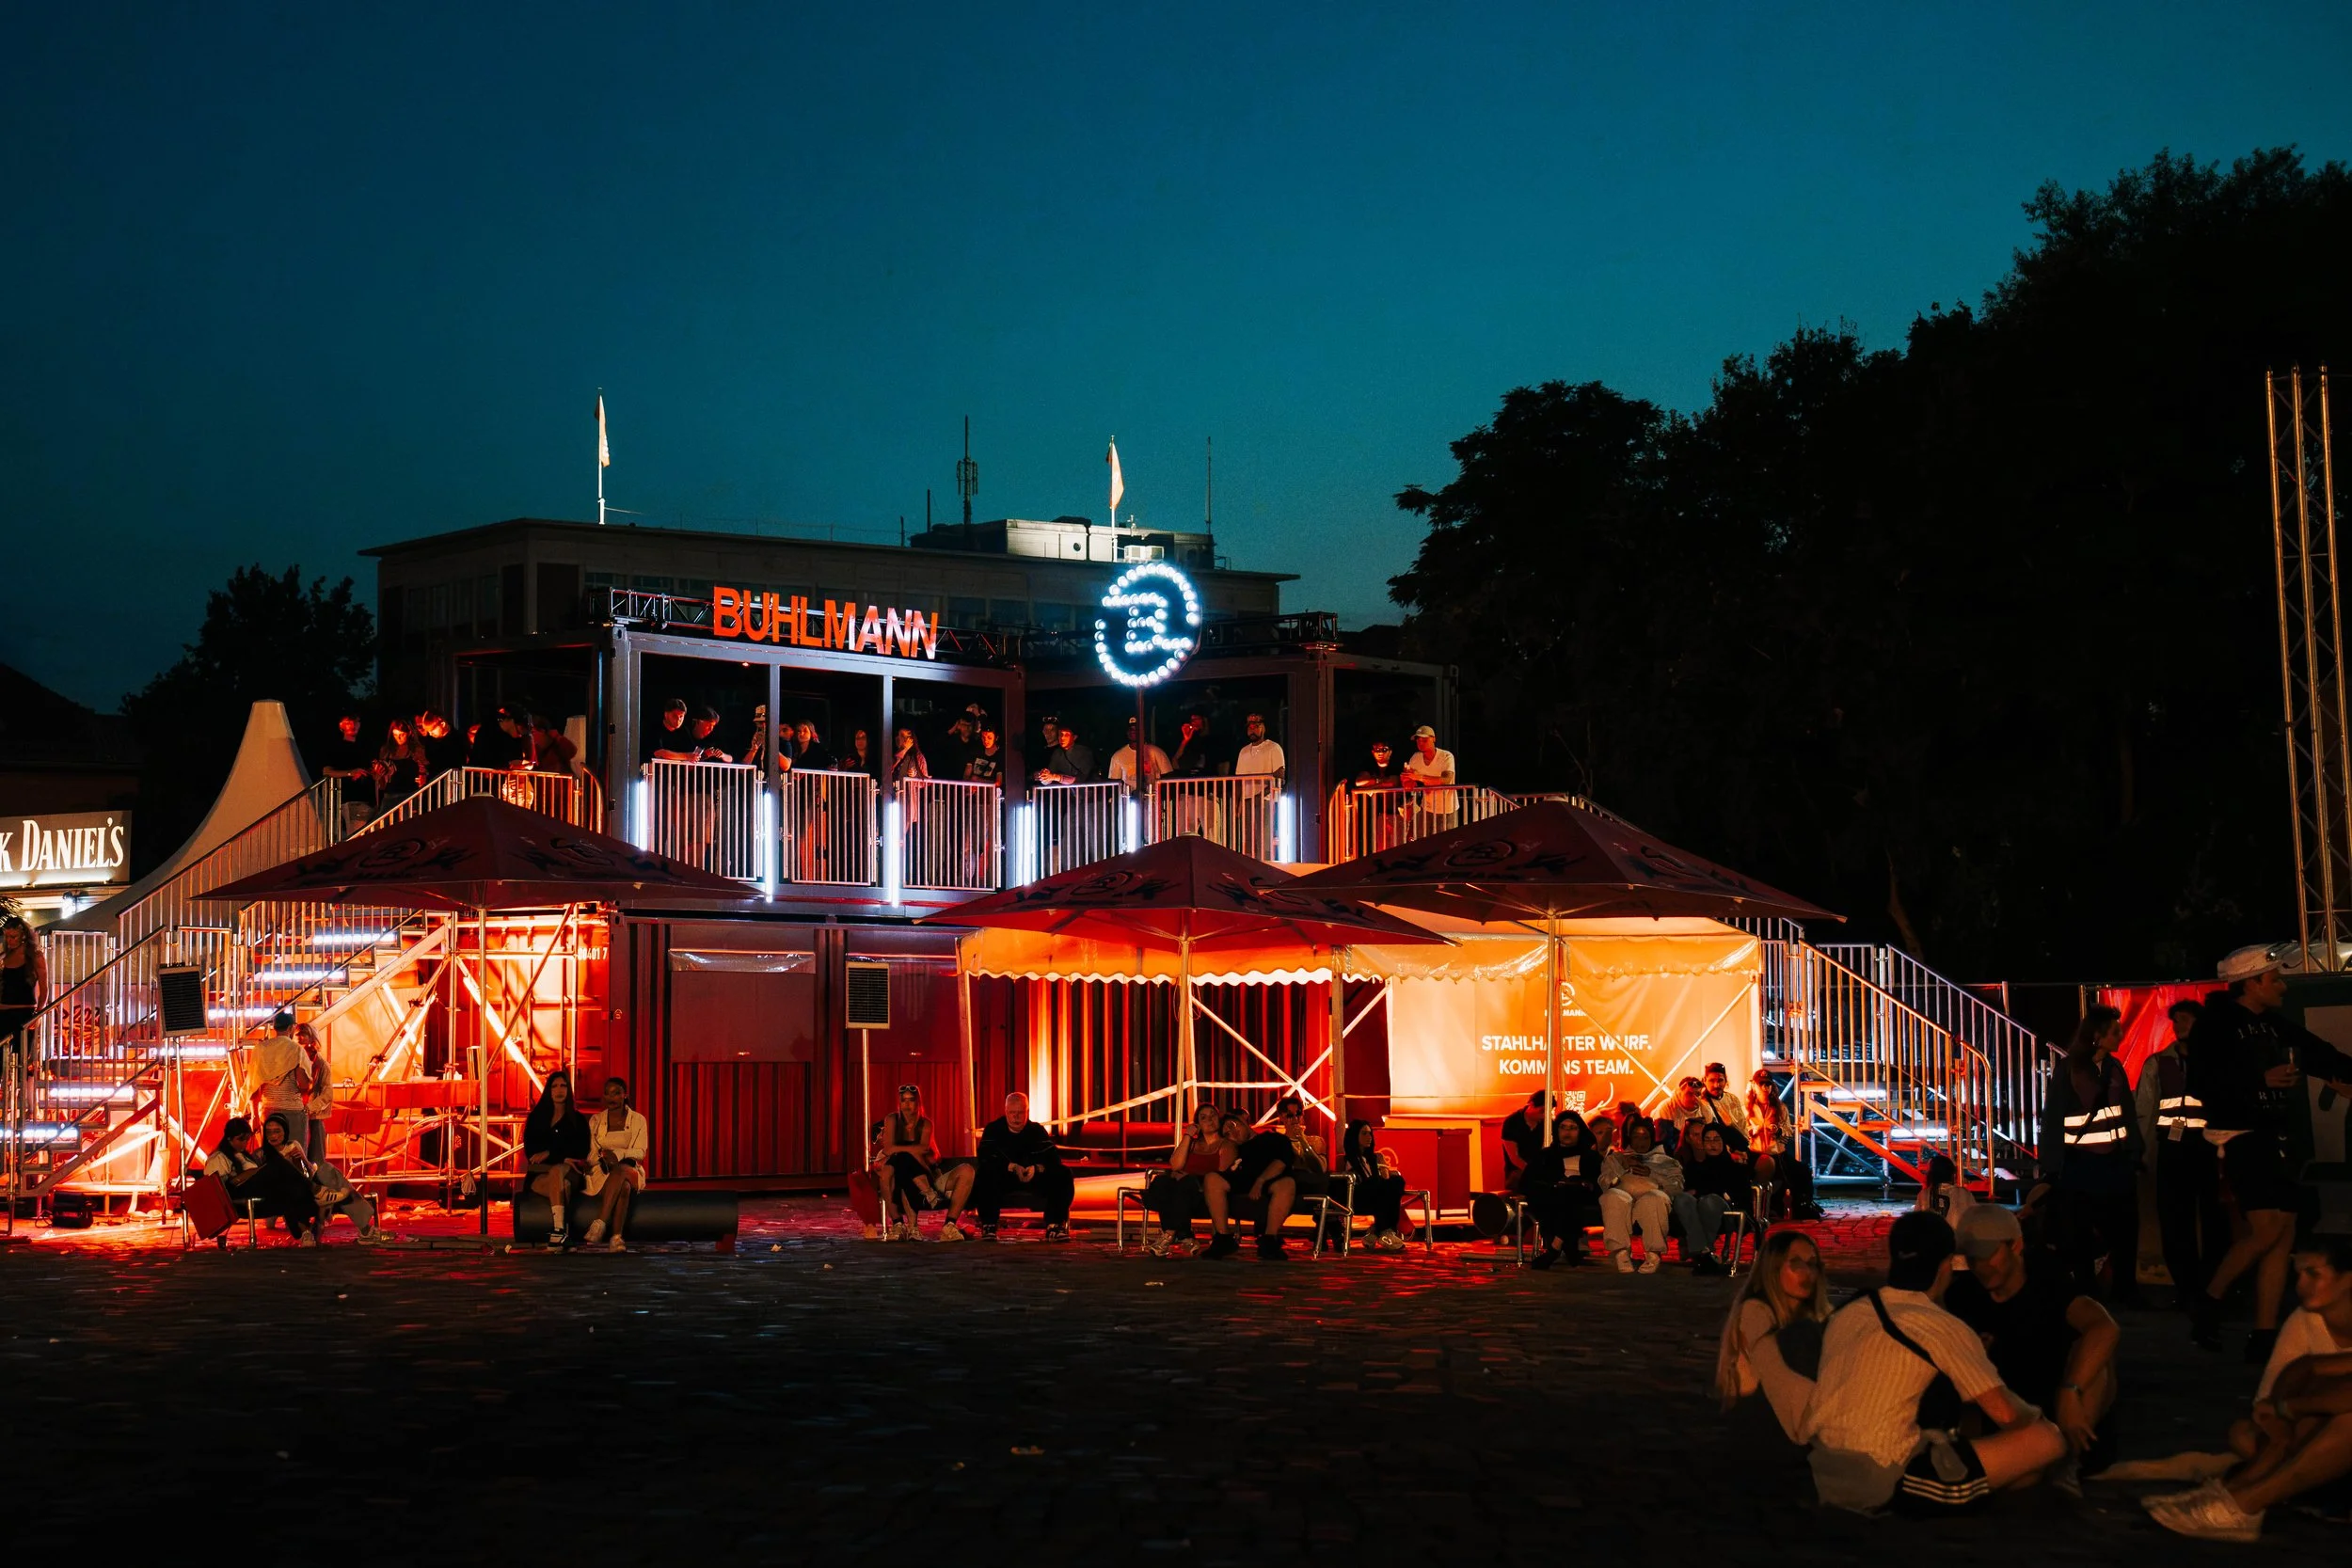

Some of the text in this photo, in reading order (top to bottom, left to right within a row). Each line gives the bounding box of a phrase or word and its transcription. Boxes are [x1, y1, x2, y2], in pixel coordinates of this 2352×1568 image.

[713, 586, 938, 659] BUHLMANN
[20, 816, 124, 872] DANIEL'S
[1481, 1035, 1596, 1051] STAHLHTER
[1584, 1058, 1634, 1075] TEAM.
